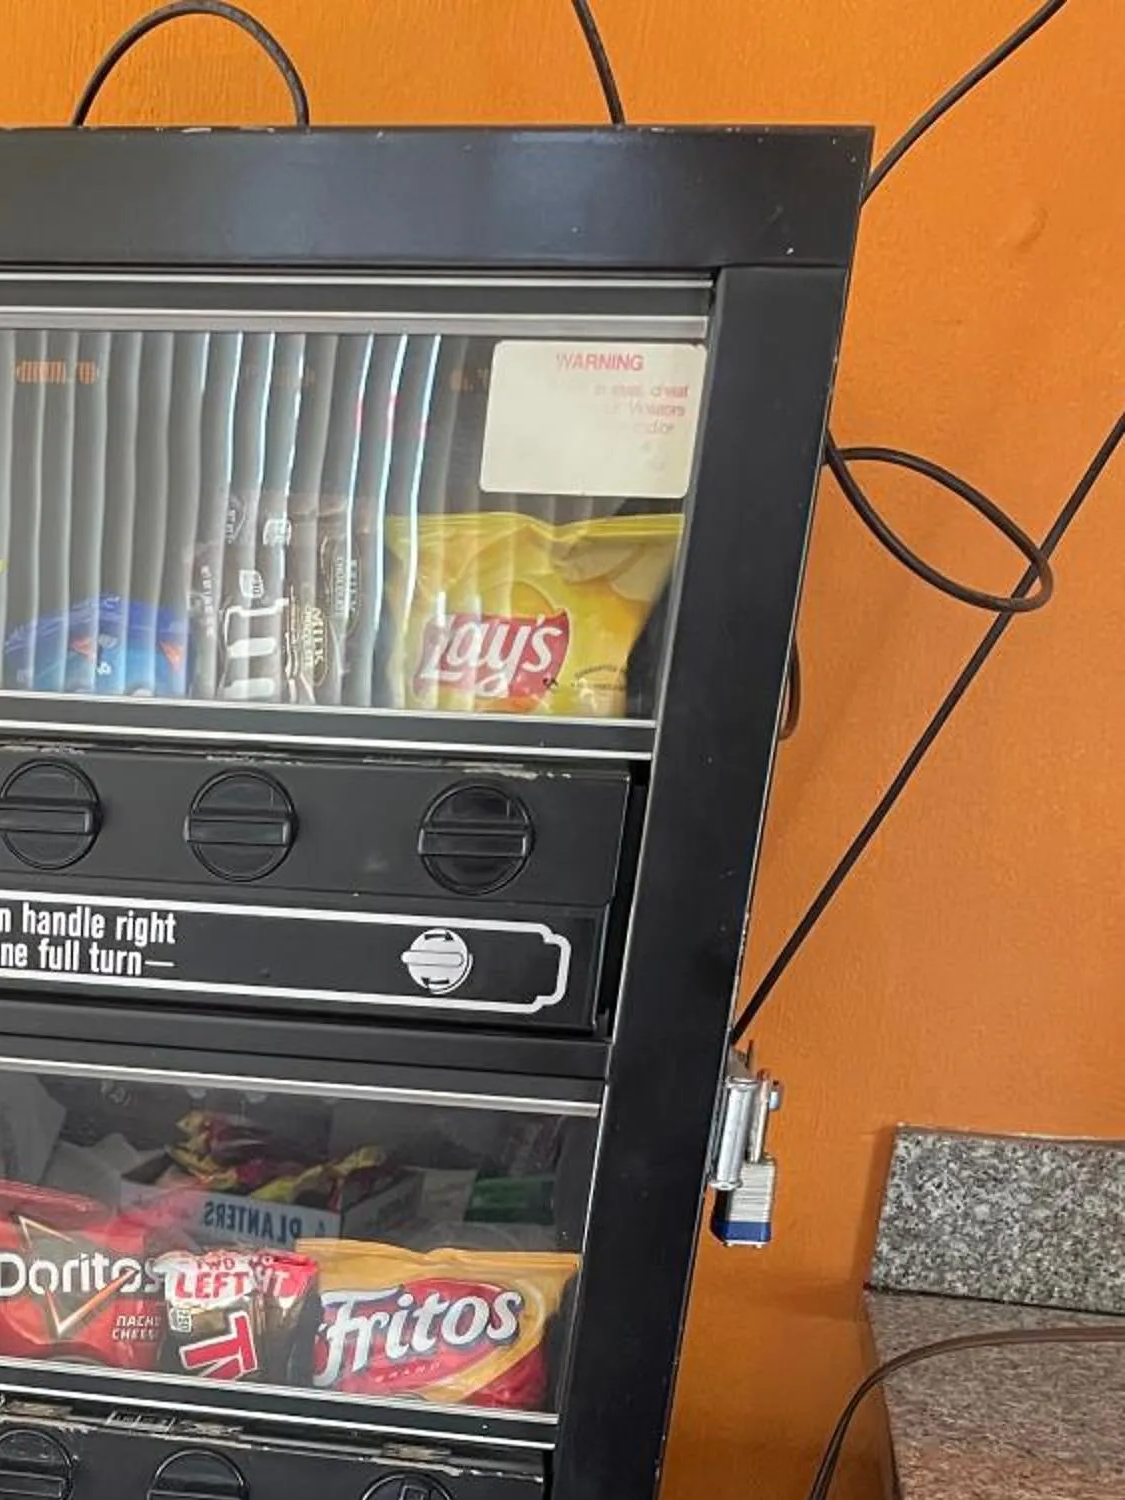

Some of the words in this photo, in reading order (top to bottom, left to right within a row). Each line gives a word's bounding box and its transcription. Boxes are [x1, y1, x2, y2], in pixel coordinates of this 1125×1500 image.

[557, 353, 644, 371] WARNING
[22, 901, 105, 939] handle
[115, 910, 177, 948] right
[38, 938, 80, 971] full
[175, 1272, 250, 1299] LEFT
[313, 1288, 523, 1386] Fritos
